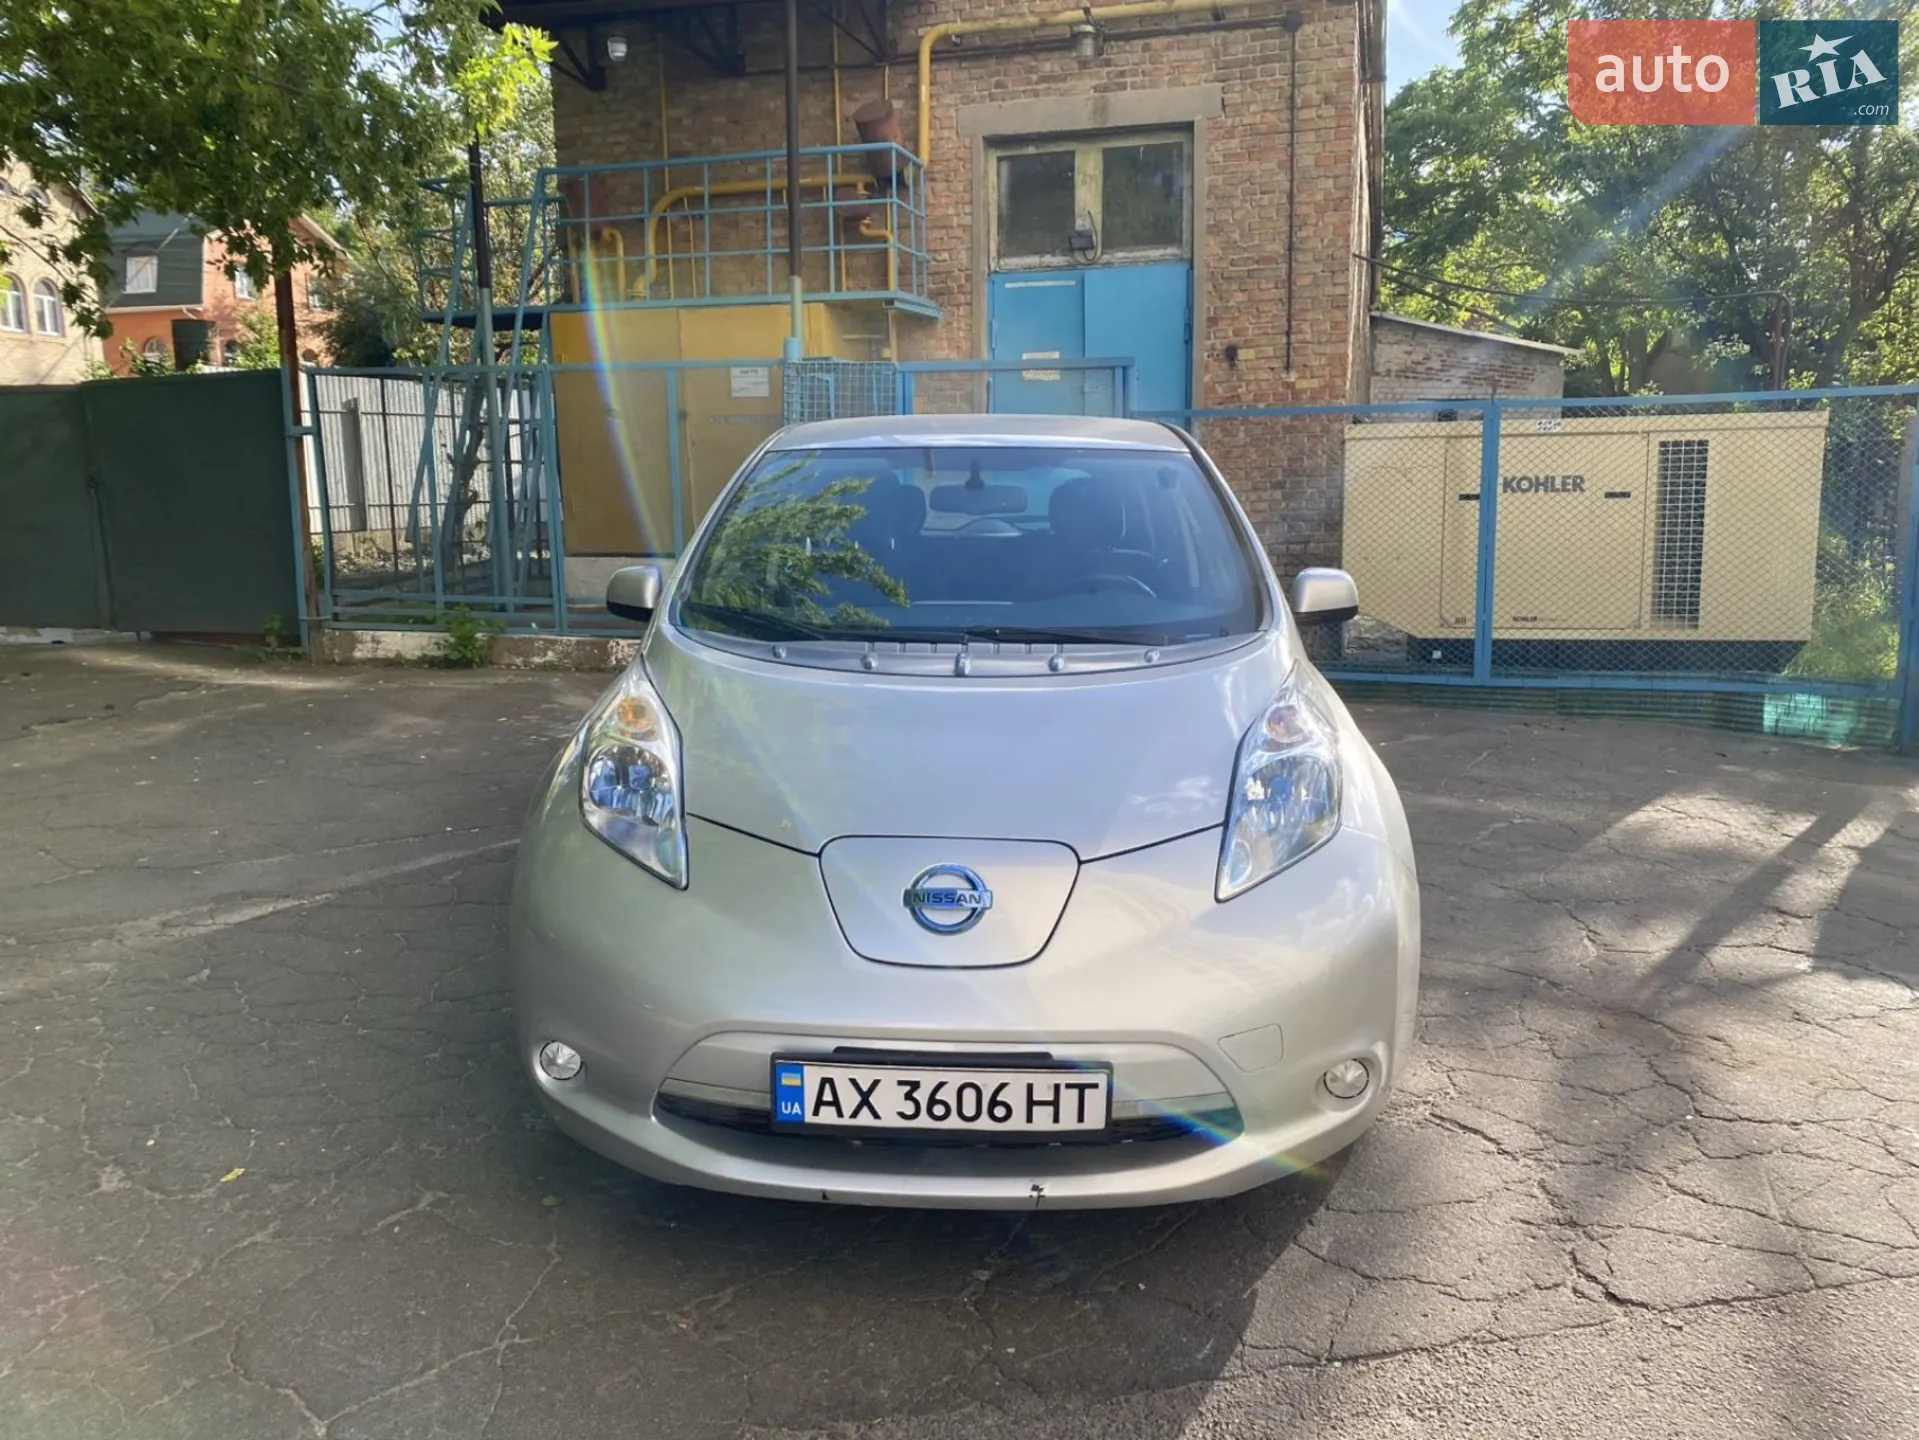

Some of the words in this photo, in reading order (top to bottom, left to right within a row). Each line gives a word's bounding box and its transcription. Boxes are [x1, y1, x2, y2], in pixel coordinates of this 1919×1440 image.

[1502, 475, 1586, 494] KOHLER
[913, 892, 982, 905] NISSAN
[812, 1077, 882, 1120] AX
[896, 1080, 1014, 1122] 3606
[1027, 1083, 1100, 1124] HT
[781, 1102, 803, 1116] UA
